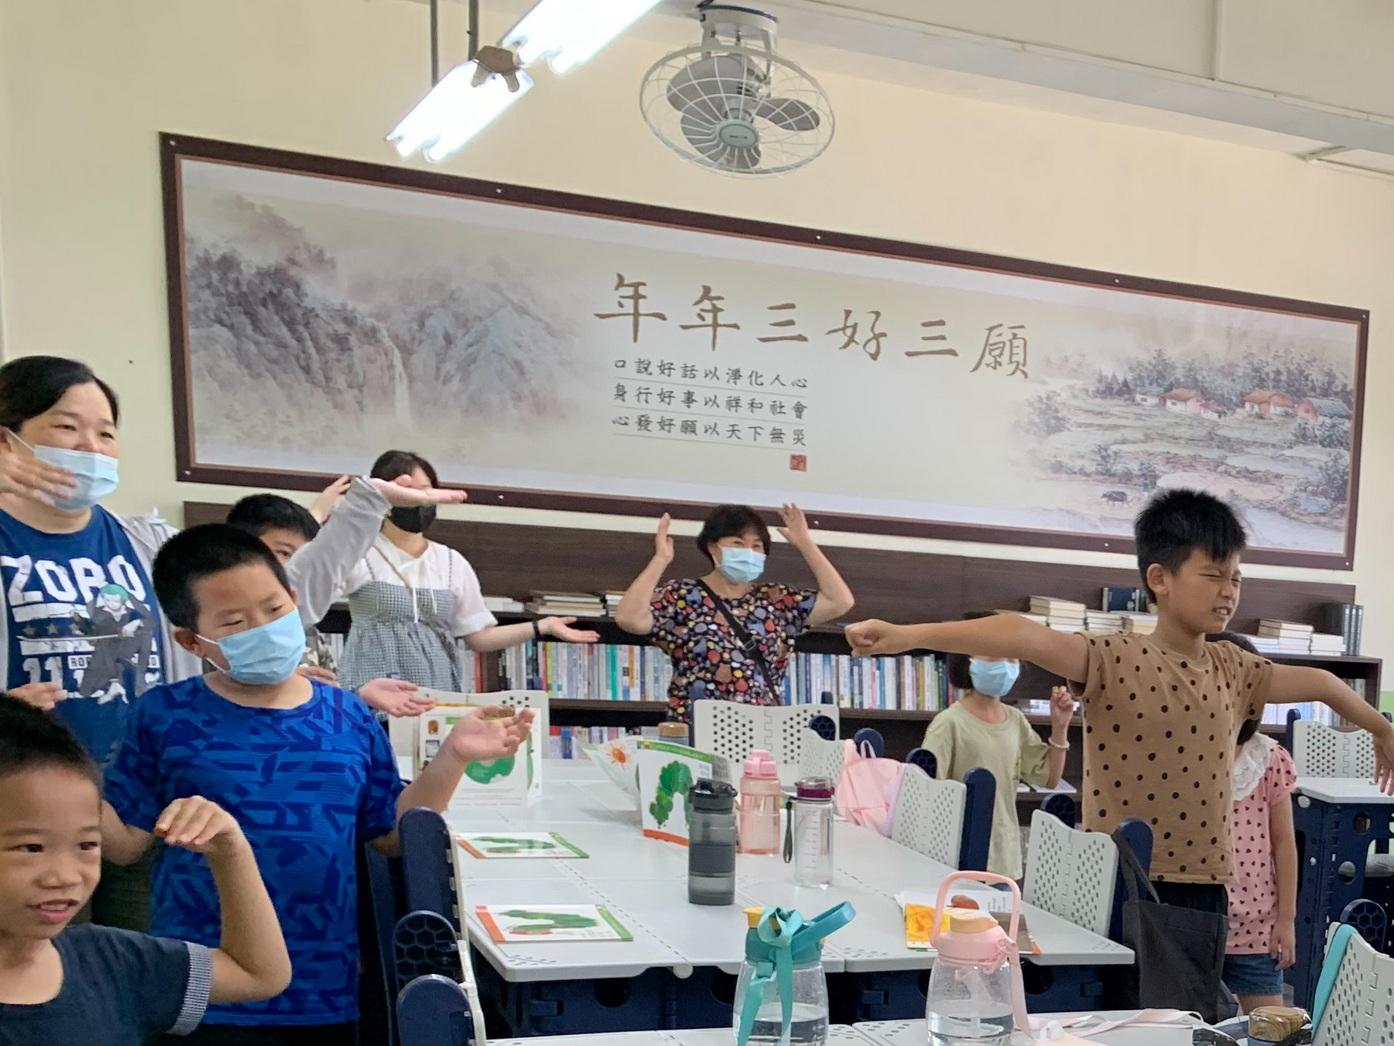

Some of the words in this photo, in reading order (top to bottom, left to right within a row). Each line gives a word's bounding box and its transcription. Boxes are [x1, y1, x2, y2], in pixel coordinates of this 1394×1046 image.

[593, 272, 1030, 379] 年年三好三願
[614, 357, 809, 389] 口說好話以淨化人心
[613, 382, 809, 420] 身行好事以祥和社會
[611, 413, 807, 447] 心發好願以天下無災
[0, 555, 146, 606] ZORO
